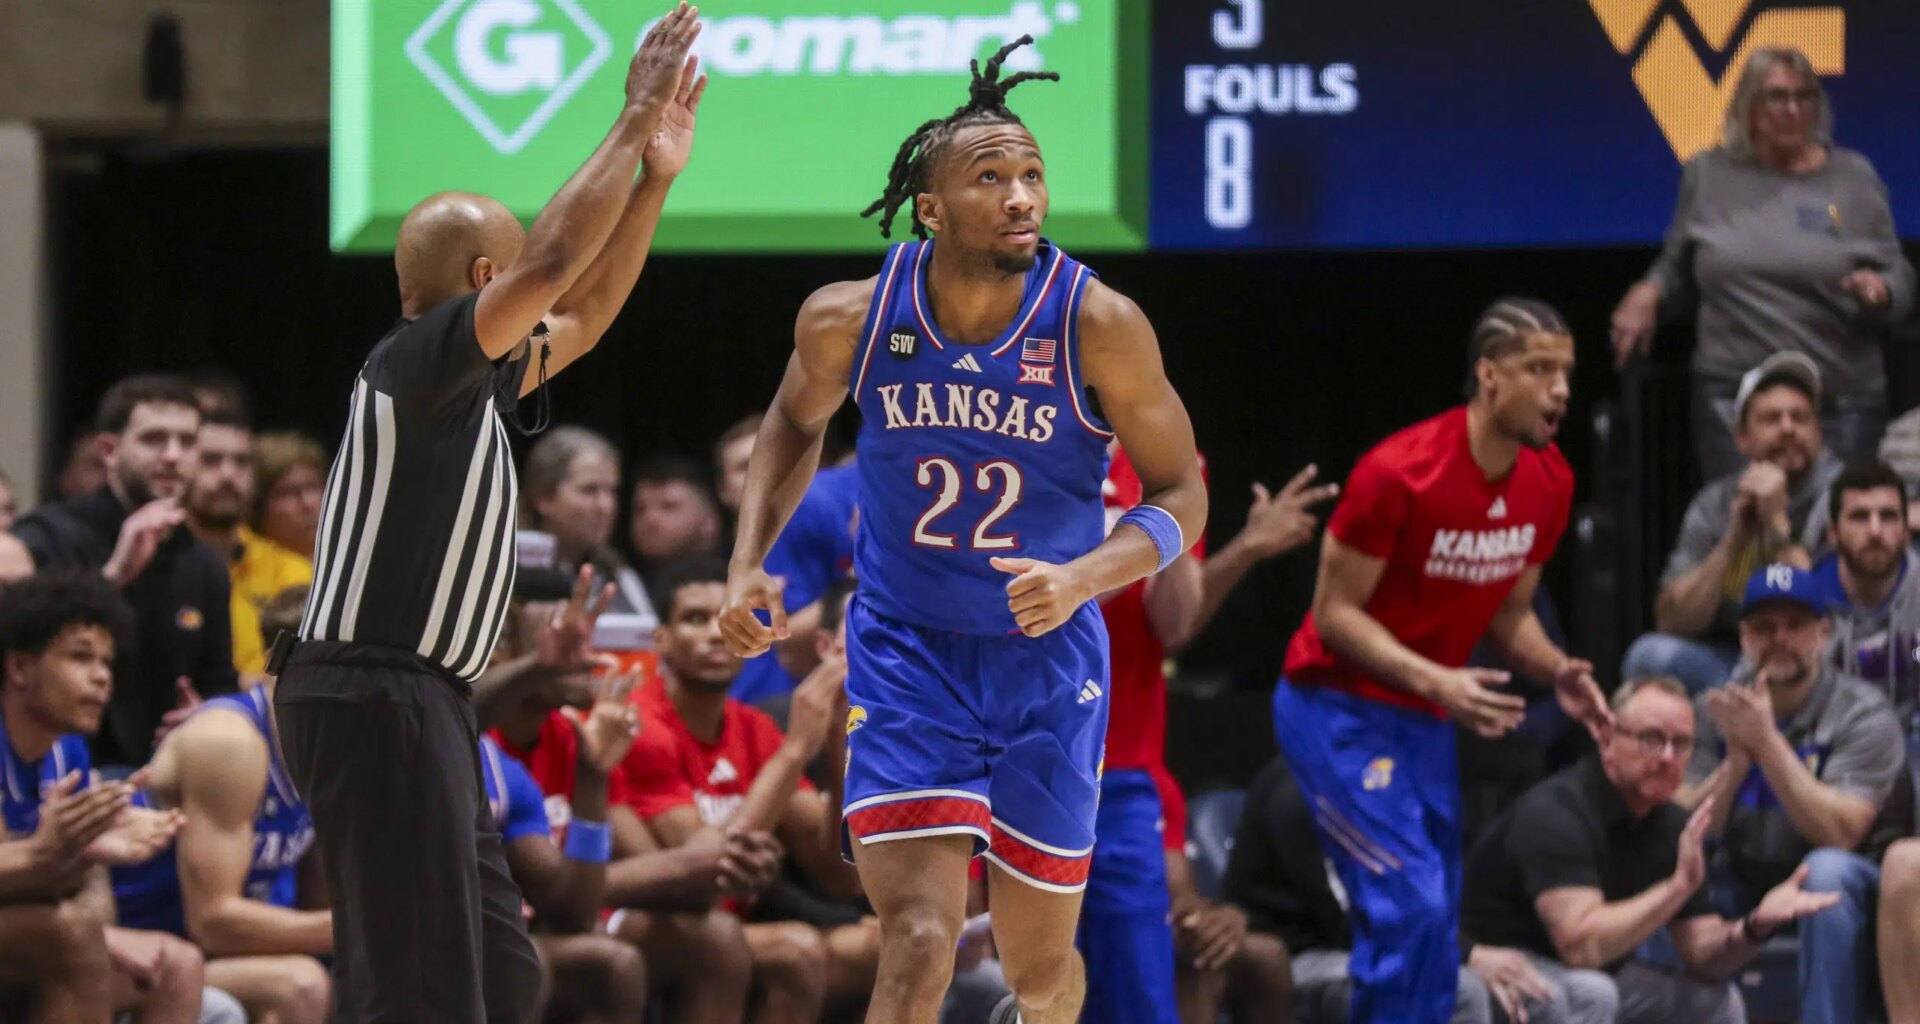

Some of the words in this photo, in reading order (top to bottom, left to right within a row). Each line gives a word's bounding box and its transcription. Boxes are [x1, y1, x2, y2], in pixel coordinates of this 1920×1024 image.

[455, 0, 562, 95] G
[635, 0, 1051, 74] omart
[1184, 62, 1359, 115] FOULS
[1204, 117, 1252, 228] 8
[888, 333, 916, 354] SW
[1018, 364, 1055, 386] XII
[876, 382, 1058, 443] KANSAS
[912, 455, 1024, 551] 22
